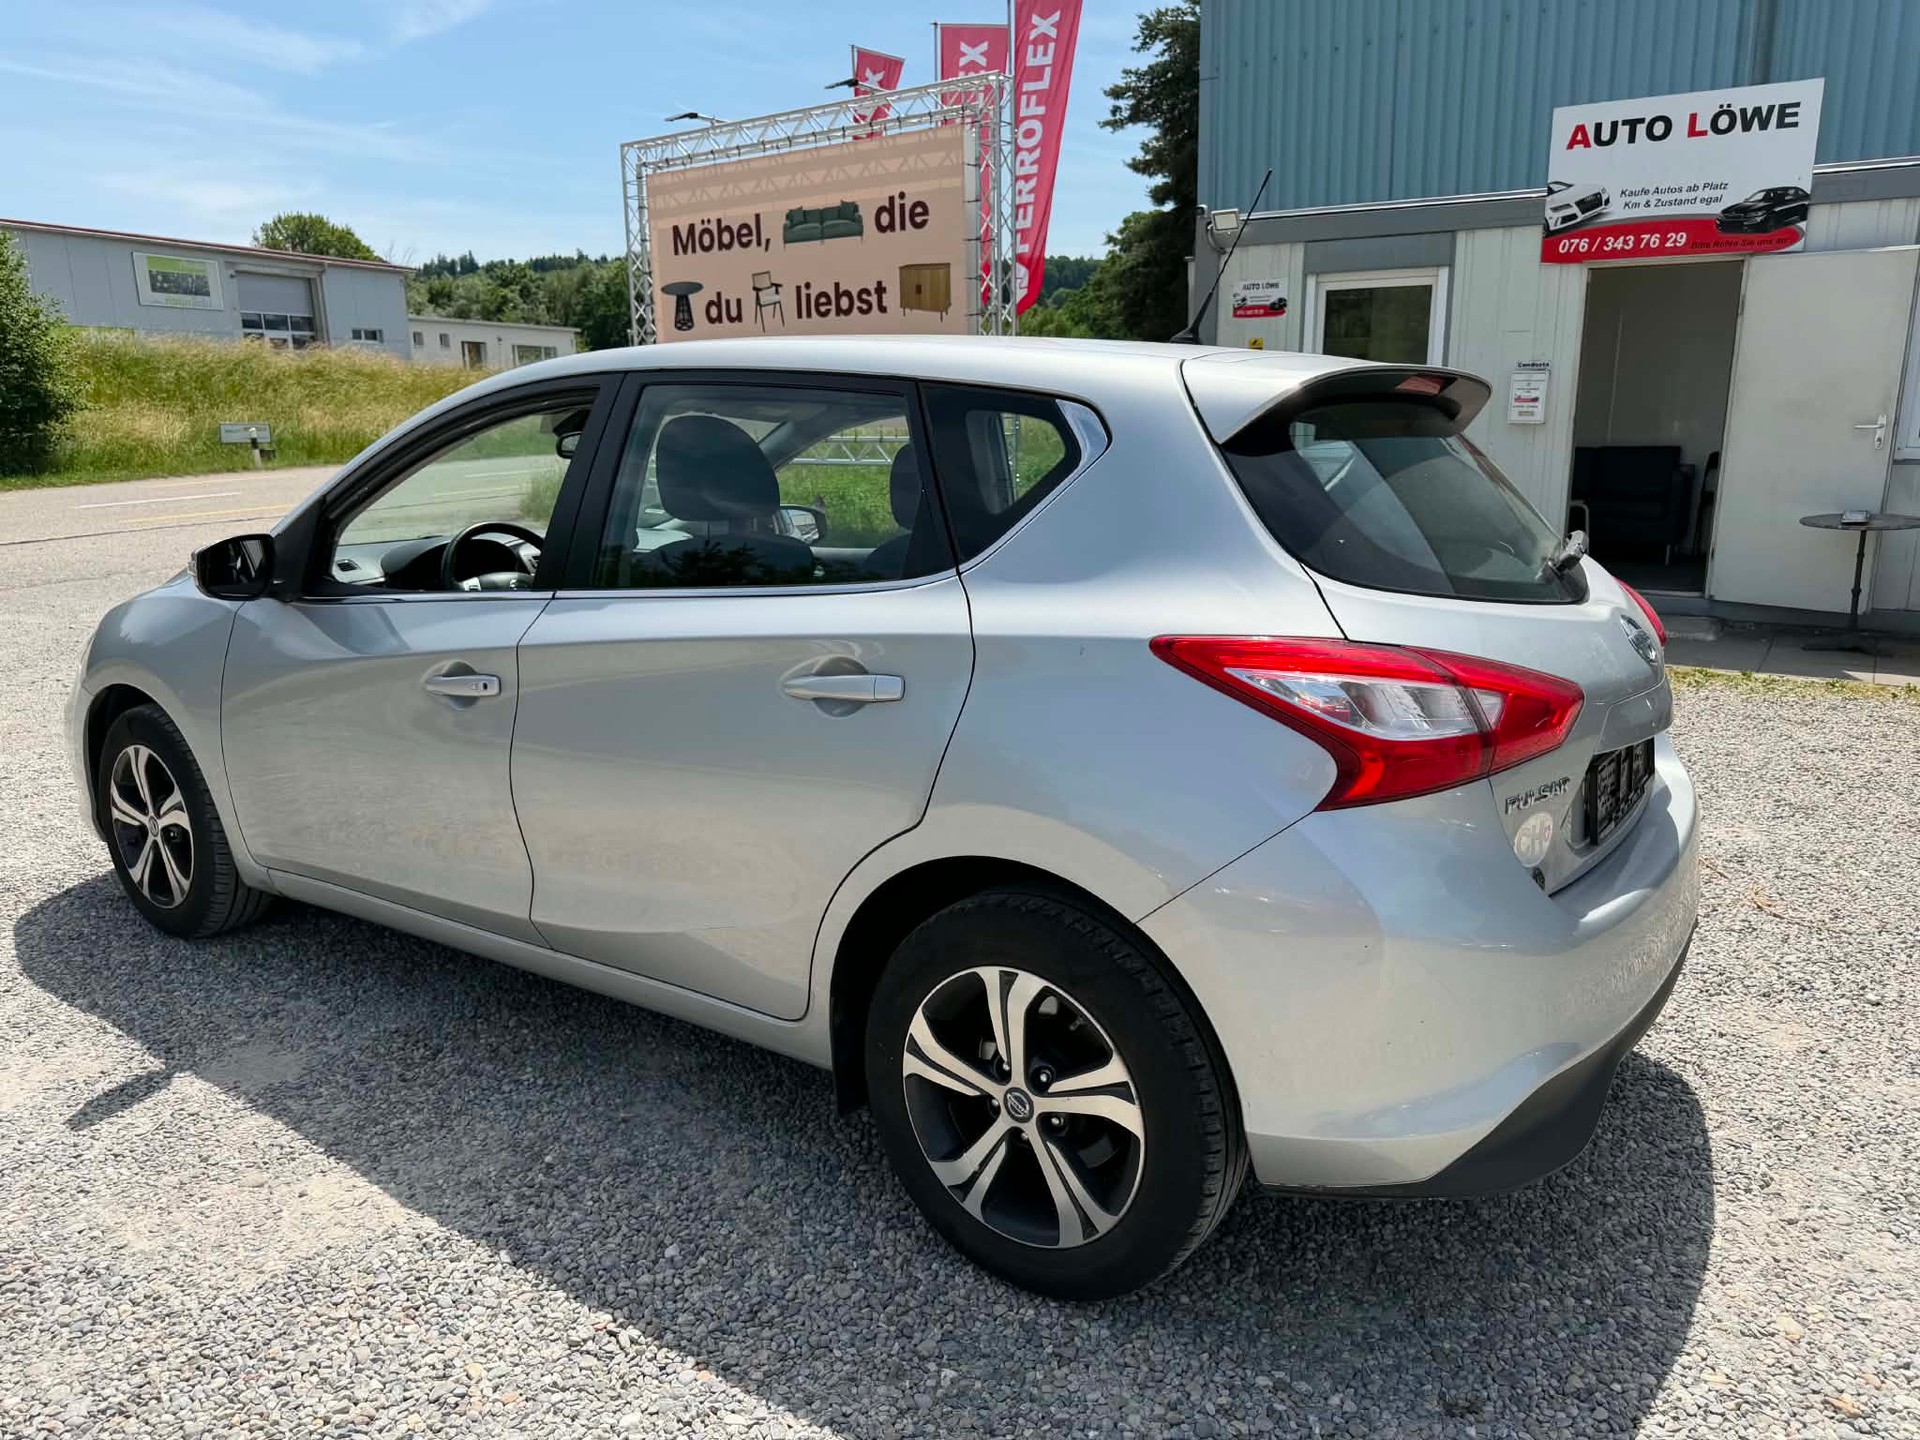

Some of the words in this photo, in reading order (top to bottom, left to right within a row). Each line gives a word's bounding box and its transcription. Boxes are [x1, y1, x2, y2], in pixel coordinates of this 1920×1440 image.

[1014, 10, 1061, 253] FERROFLEX
[1566, 115, 1673, 150] AUTO
[1687, 102, 1801, 138] LÖWE
[1620, 187, 1650, 198] Kaufe
[1652, 186, 1683, 196] Autos
[1685, 183, 1699, 193] ab
[1702, 181, 1729, 191] Platz
[1623, 200, 1641, 210] Km
[1643, 199, 1651, 208] &
[1654, 196, 1698, 208] Zustand
[1699, 194, 1723, 206] egal
[672, 212, 771, 256] Möbel,
[874, 191, 930, 234] die
[1559, 238, 1589, 254] 076
[1591, 236, 1602, 252] /
[1603, 235, 1635, 251] 343
[1640, 233, 1661, 249] 76
[1664, 232, 1687, 248] 29
[704, 290, 743, 325] du
[796, 280, 888, 320] liebst
[1242, 283, 1260, 291] AUTO
